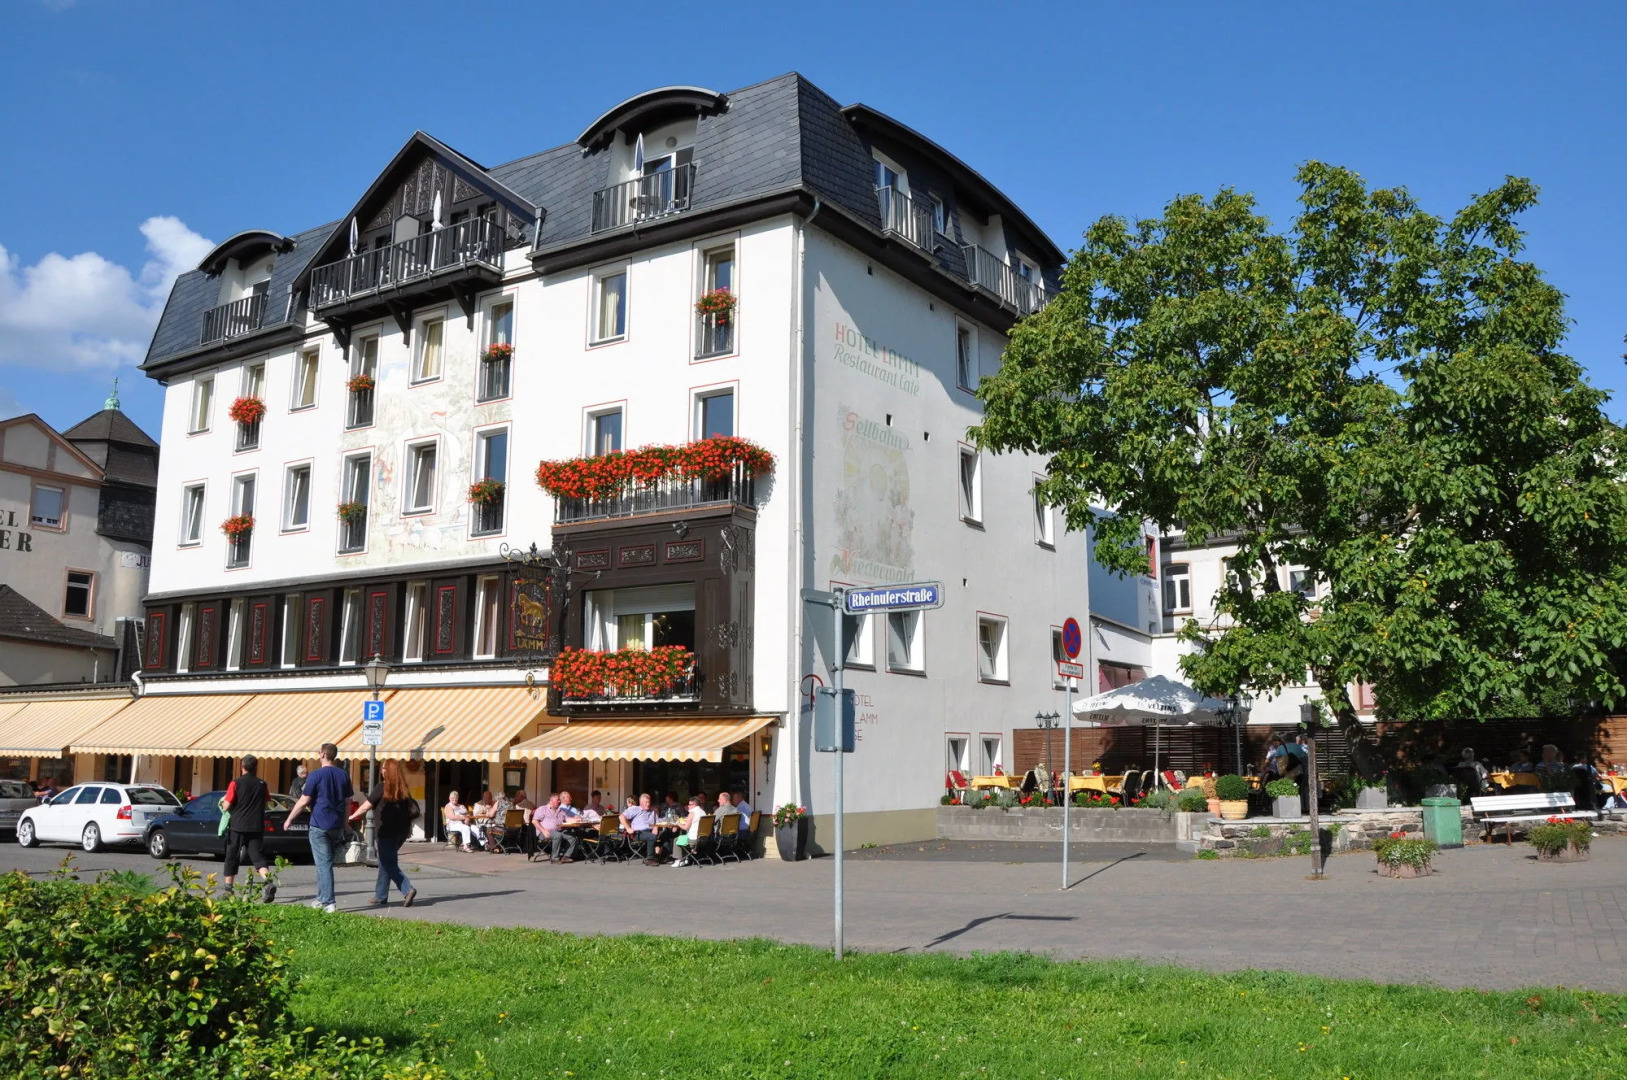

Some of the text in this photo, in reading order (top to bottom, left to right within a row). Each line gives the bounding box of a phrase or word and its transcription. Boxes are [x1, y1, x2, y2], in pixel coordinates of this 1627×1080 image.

[836, 322, 919, 378] HOTEL LAMM
[833, 343, 898, 387] Restaurant
[851, 588, 933, 607] Rheinuferstraße
[517, 638, 544, 651] LAMM
[368, 703, 380, 720] P
